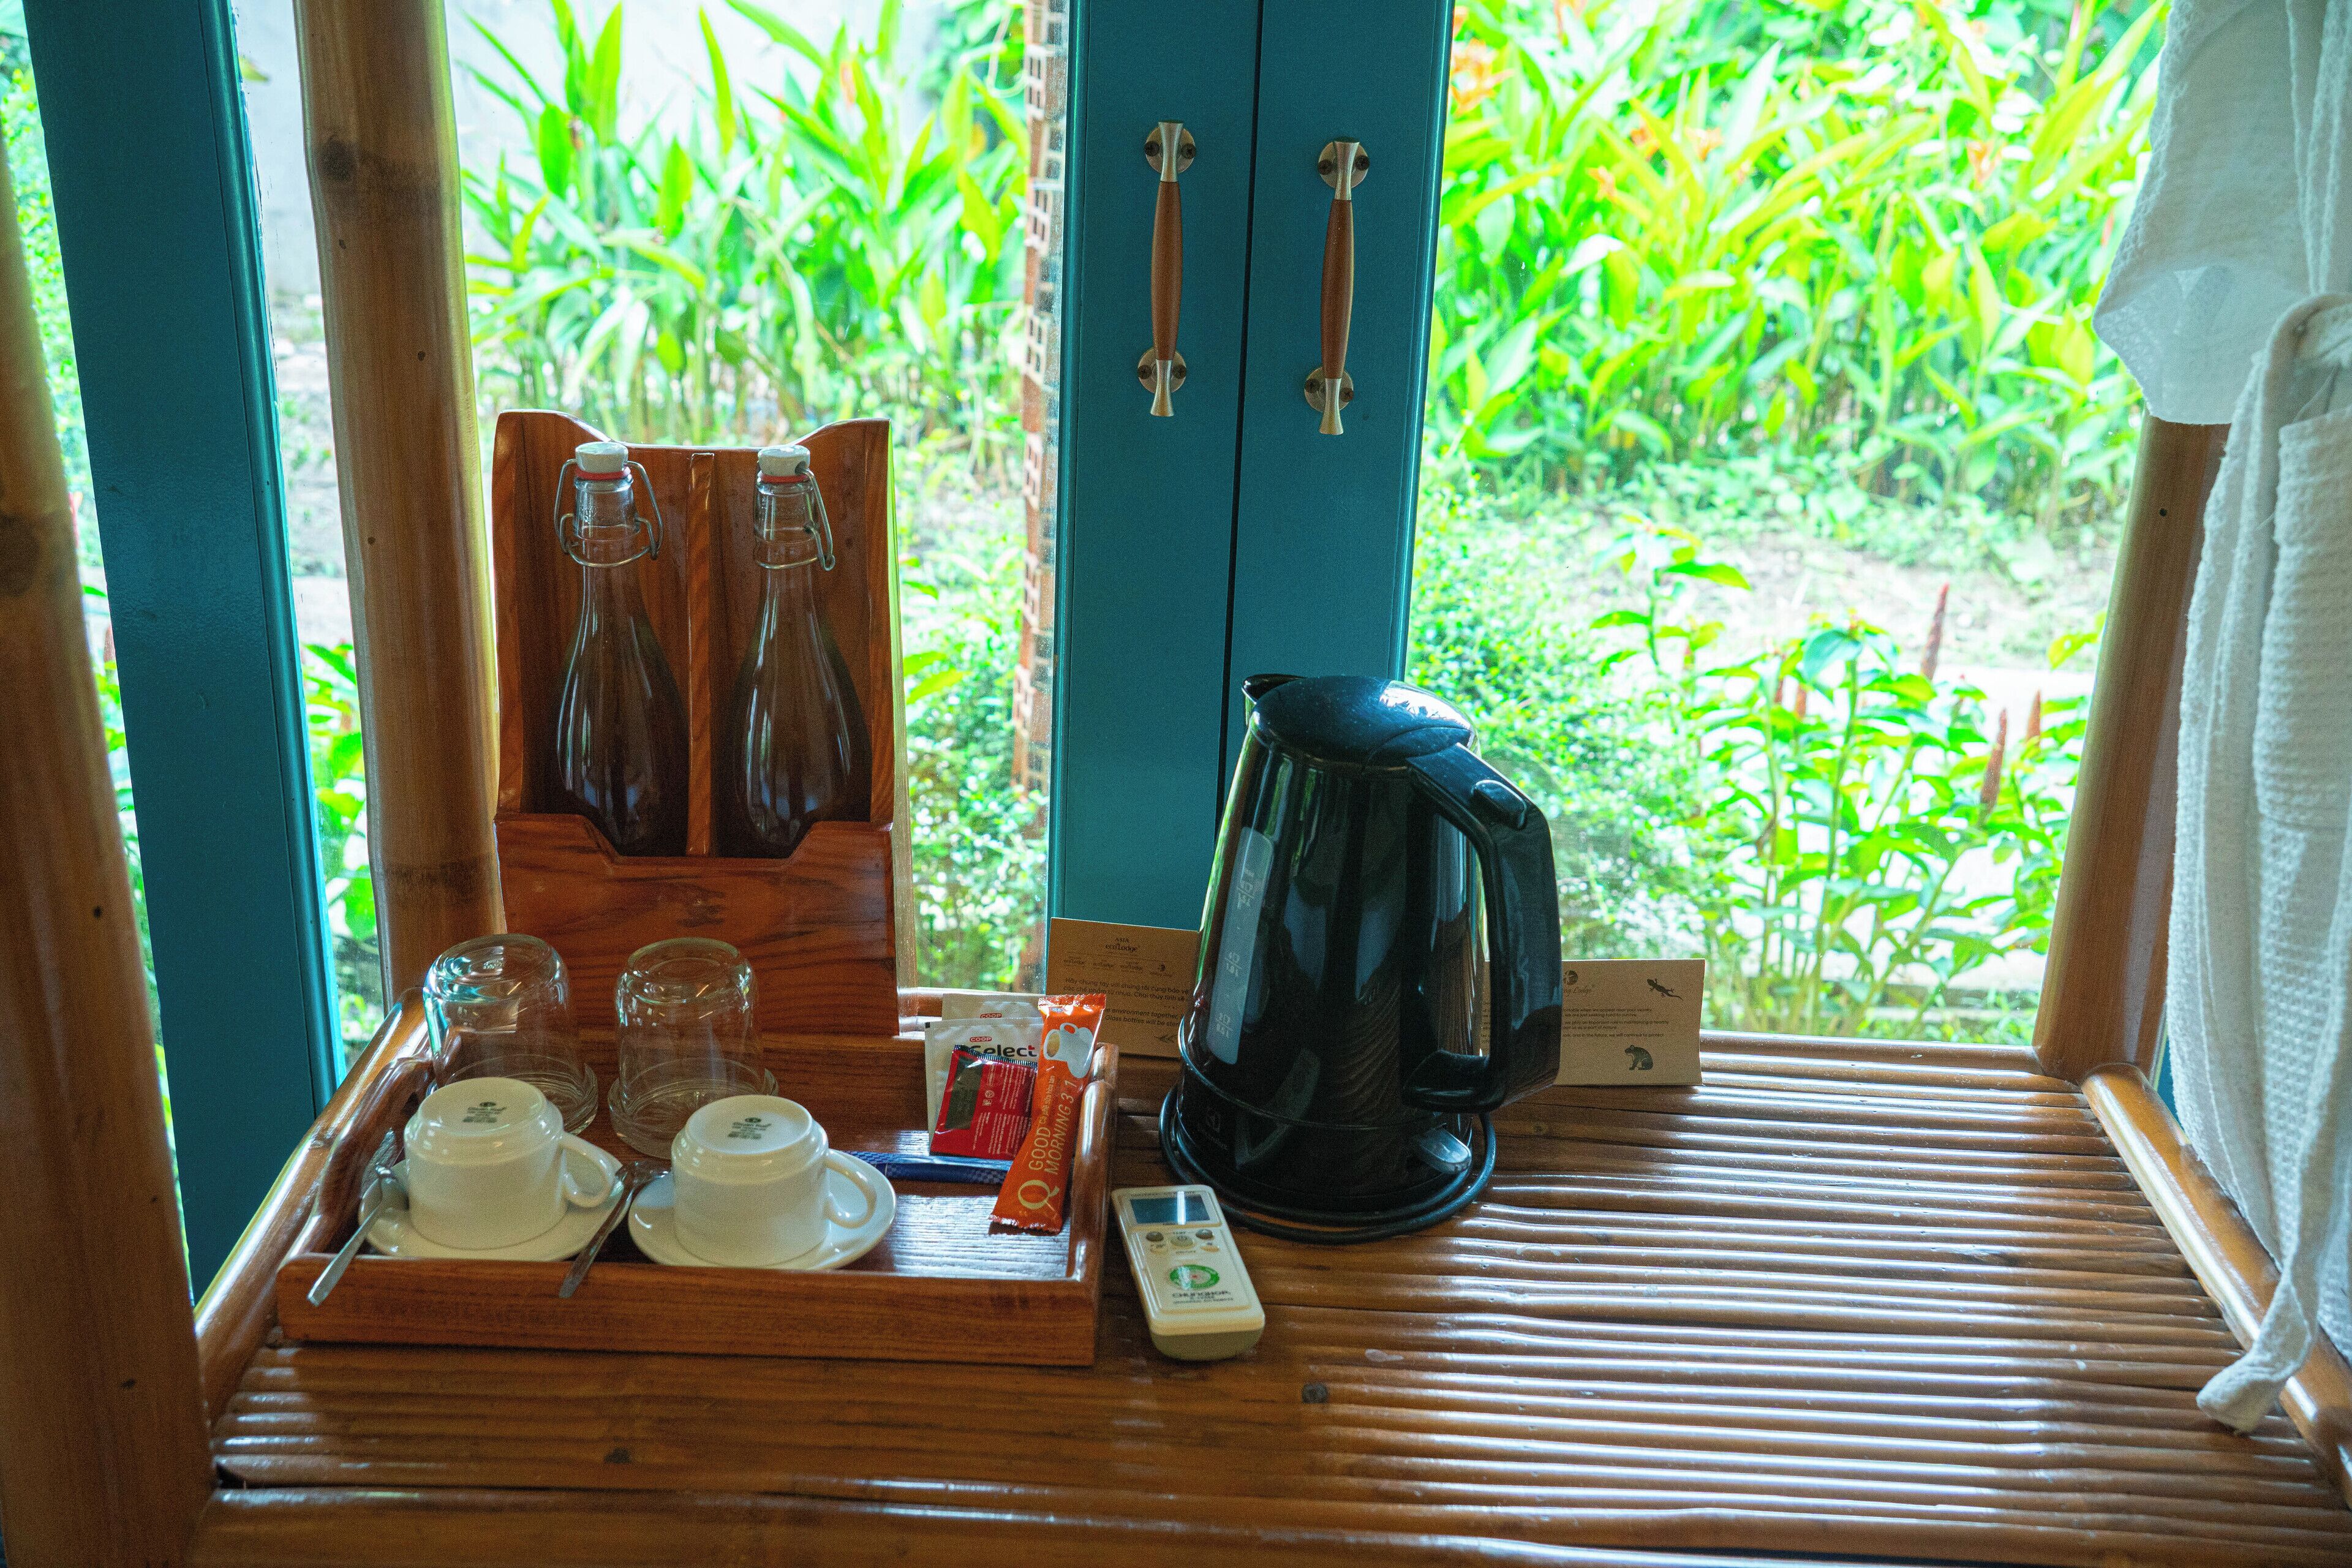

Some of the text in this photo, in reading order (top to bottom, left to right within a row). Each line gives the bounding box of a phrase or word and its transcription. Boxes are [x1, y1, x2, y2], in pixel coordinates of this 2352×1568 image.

[1112, 1008, 1150, 1016] environment
[1044, 1079, 1077, 1175] MORNING 3 1
[1029, 1126, 1051, 1170] GOOD
[1017, 1179, 1060, 1210] Q
